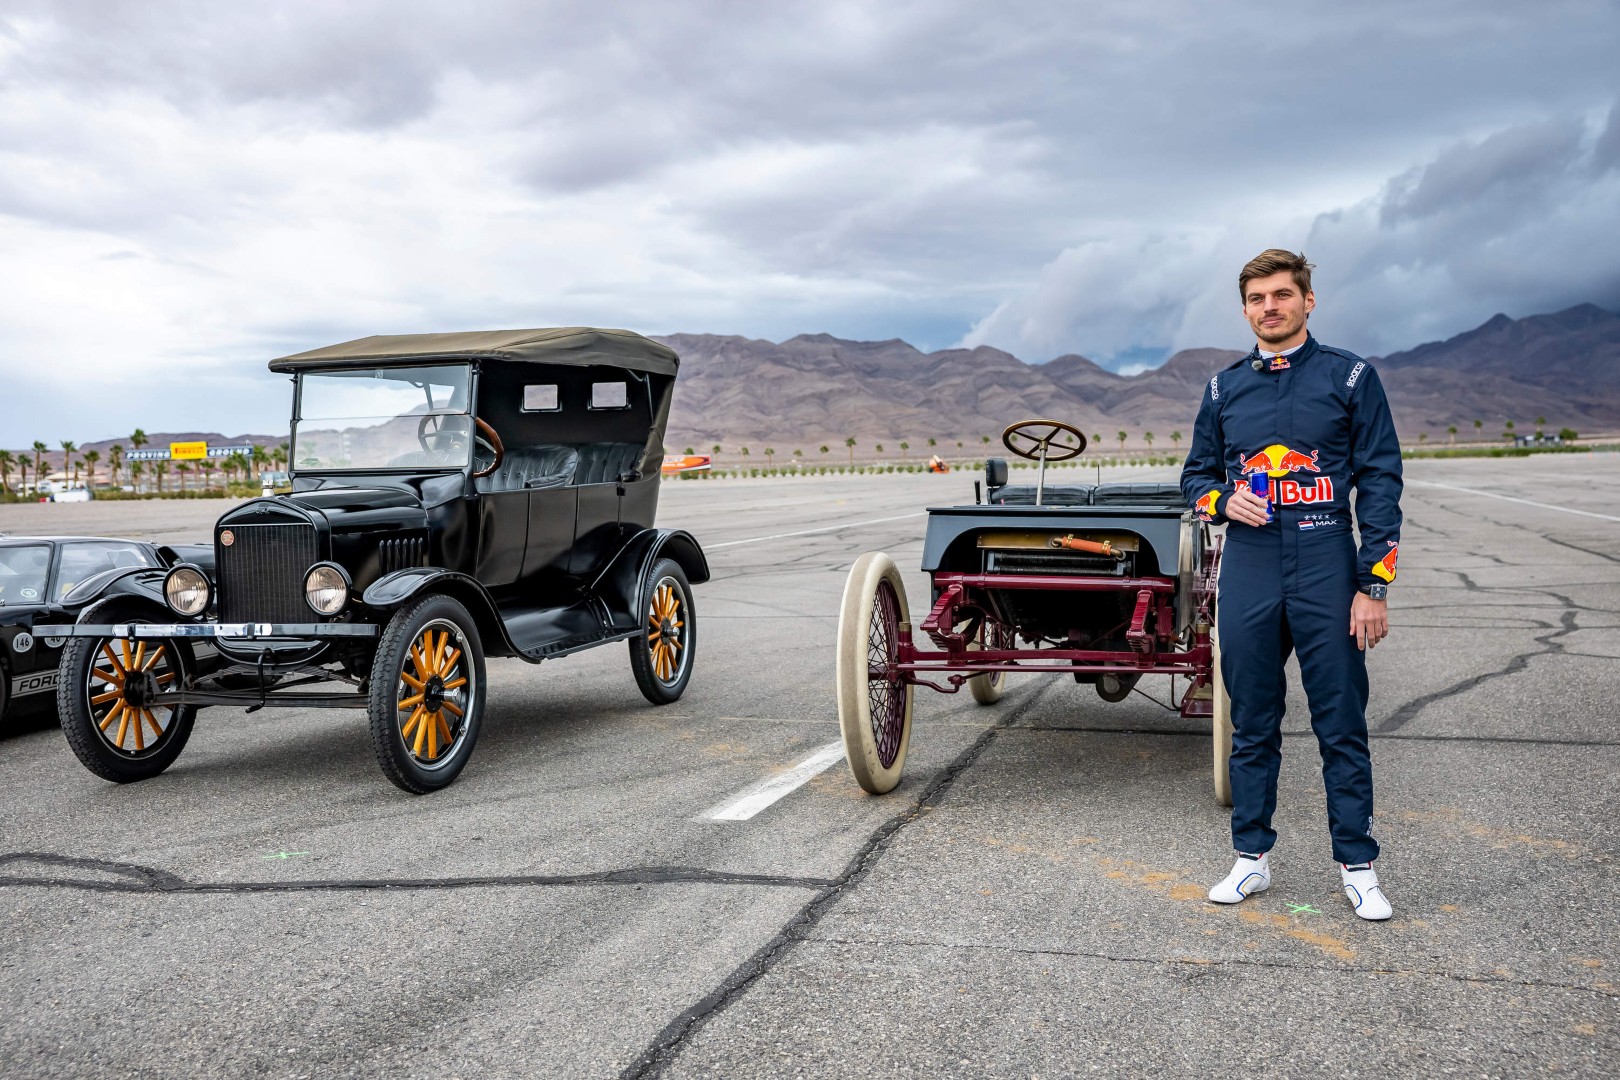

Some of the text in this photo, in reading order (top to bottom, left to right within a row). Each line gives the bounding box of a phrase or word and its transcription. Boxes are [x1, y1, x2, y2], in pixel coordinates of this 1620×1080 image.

[126, 450, 171, 460] PROVING
[1280, 476, 1334, 505] Bull
[1315, 519, 1337, 527] MAX
[16, 637, 30, 649] 146
